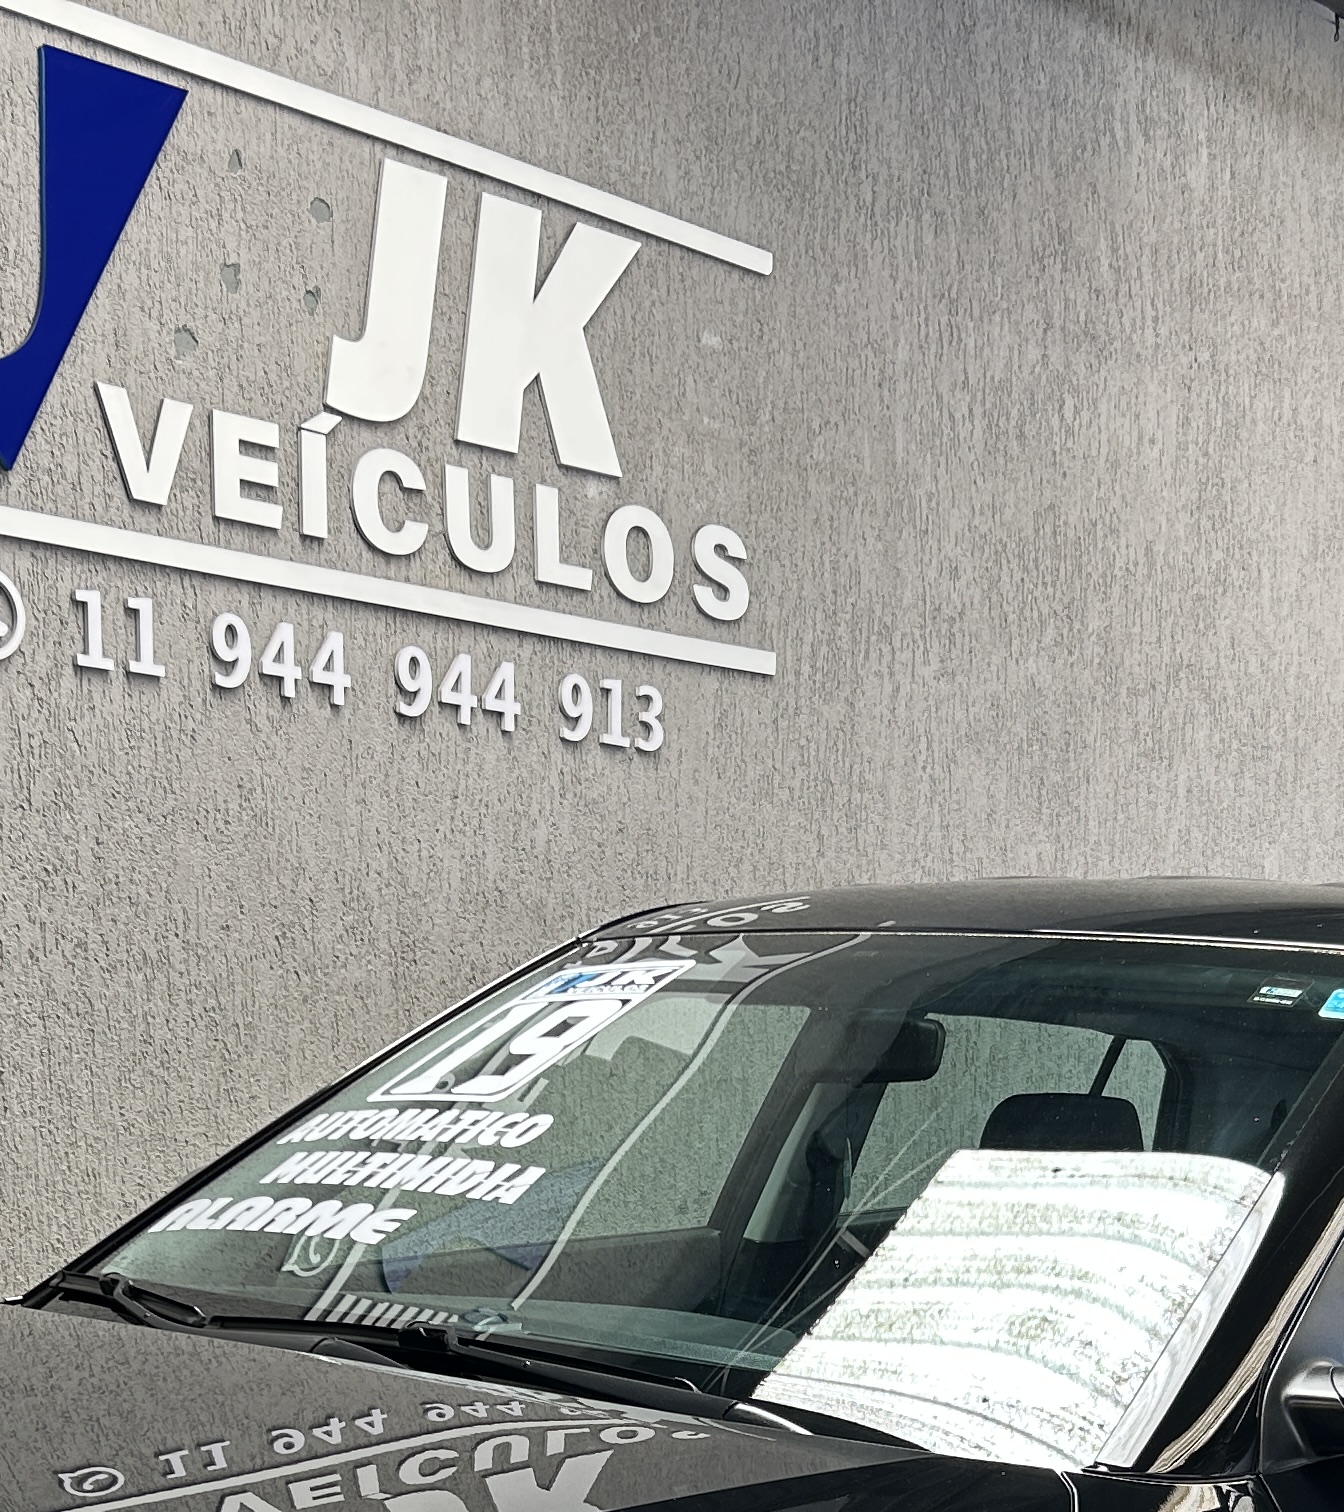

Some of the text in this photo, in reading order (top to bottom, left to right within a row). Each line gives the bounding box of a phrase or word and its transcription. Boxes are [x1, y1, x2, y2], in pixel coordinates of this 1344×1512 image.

[325, 158, 642, 478] JK
[94, 381, 750, 622] VEÍCULOS
[74, 589, 665, 753] 11 944 944 913
[148, 1196, 417, 1244] ALARME
[259, 1152, 546, 1204] MULTIMIDIA
